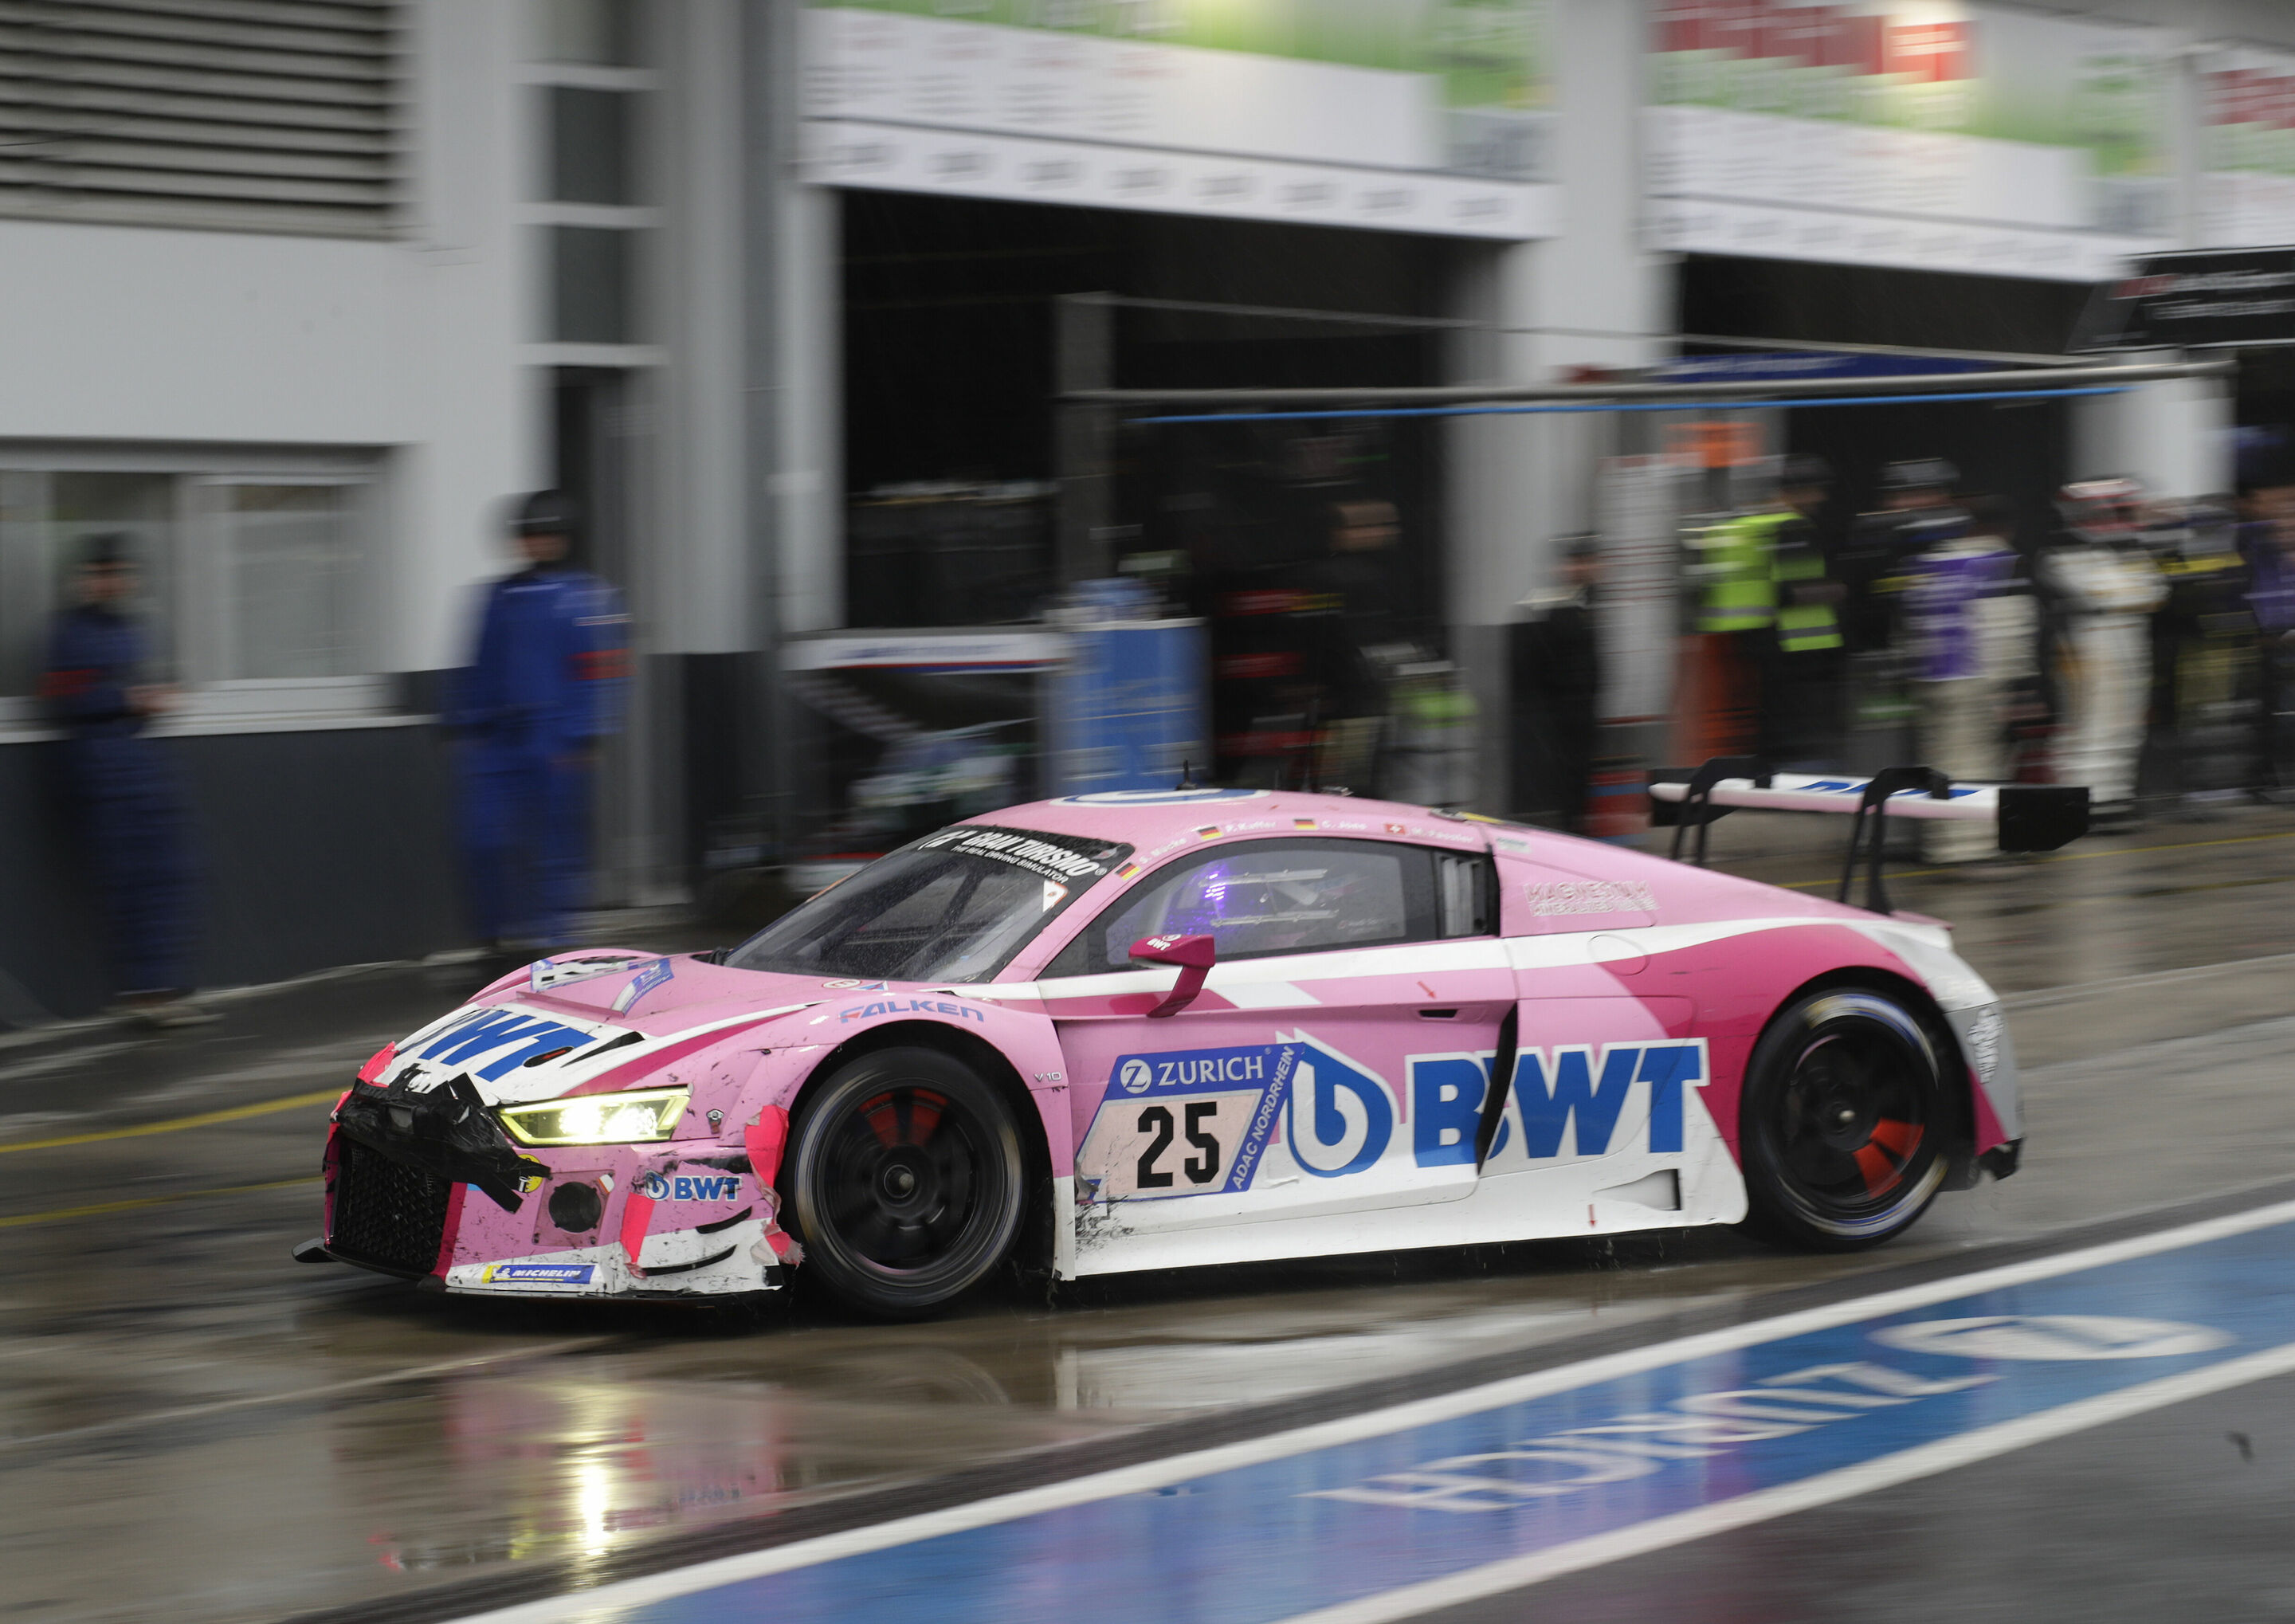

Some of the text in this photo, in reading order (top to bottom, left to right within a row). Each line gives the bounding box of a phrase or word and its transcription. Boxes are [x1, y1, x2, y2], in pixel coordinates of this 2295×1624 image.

[961, 831, 1026, 851] GRAN
[1005, 838, 1100, 877] TURISMO
[983, 850, 1021, 865] DRIVING
[1016, 859, 1069, 884] SIMULATOR
[839, 999, 985, 1024] FALKEN
[1158, 1055, 1264, 1087] ZURICH
[1232, 1045, 1297, 1191] ADAC NORDRHEIN
[1410, 1042, 1704, 1170] BWT
[1136, 1100, 1220, 1189] 25
[673, 1175, 741, 1201] BWT
[512, 1269, 582, 1278] MICHELIN
